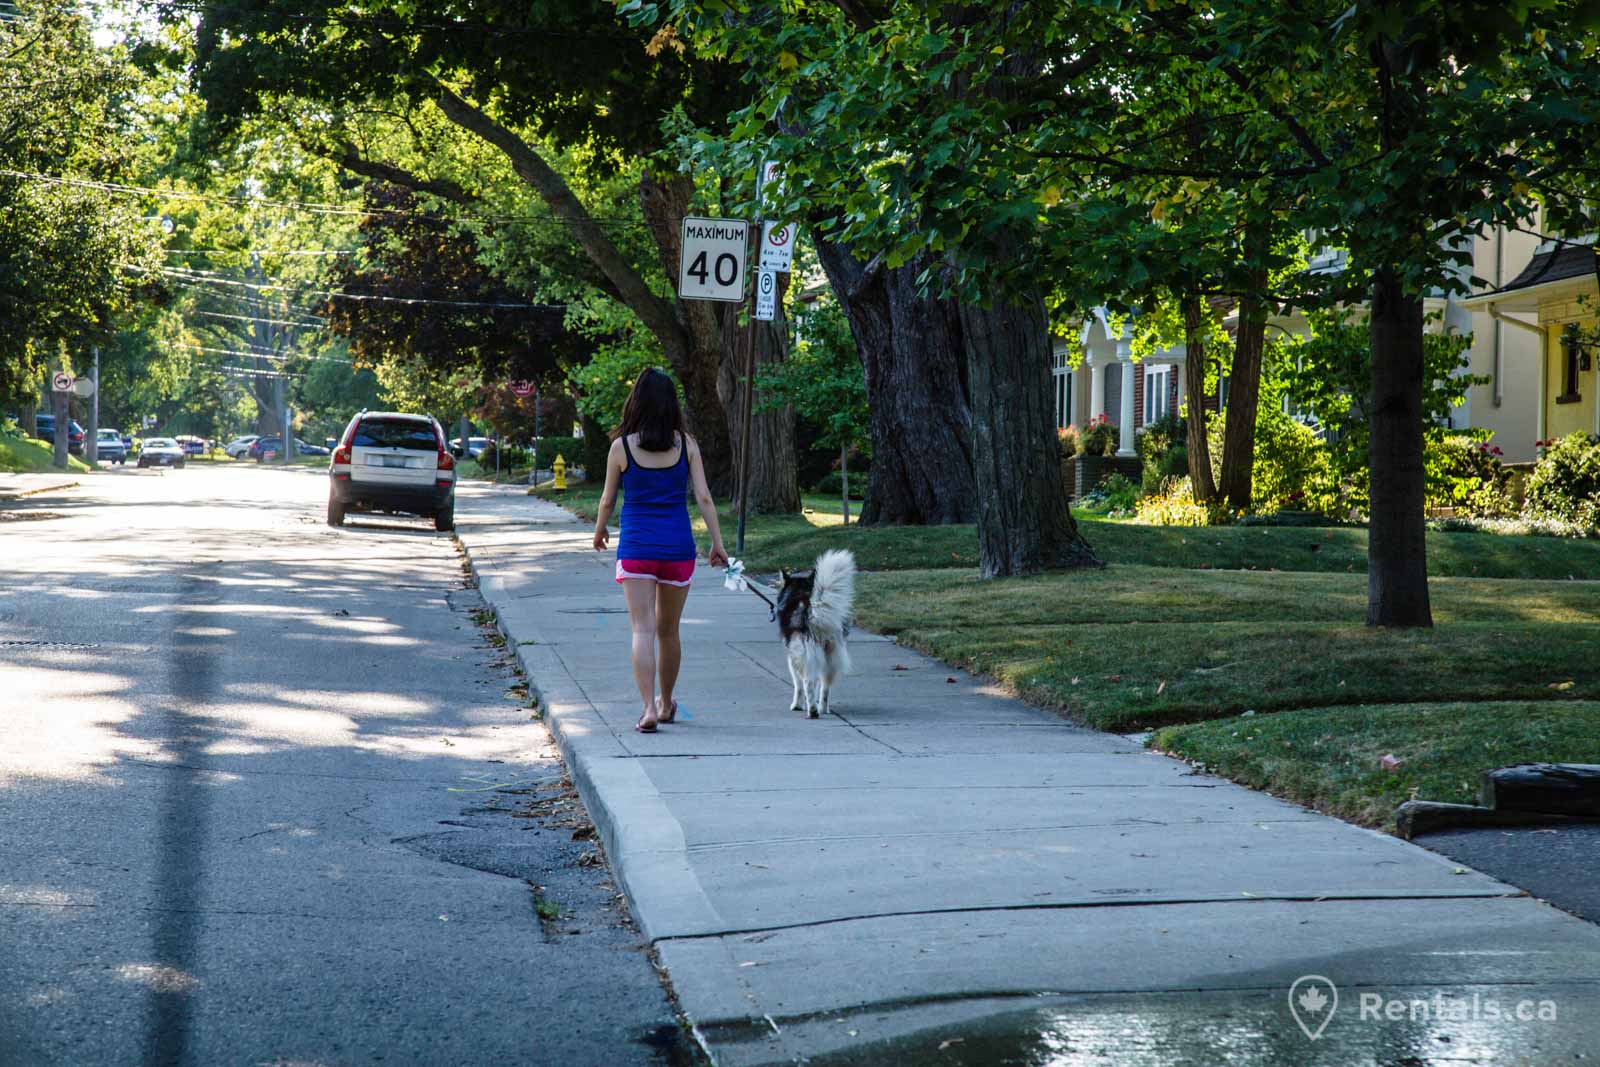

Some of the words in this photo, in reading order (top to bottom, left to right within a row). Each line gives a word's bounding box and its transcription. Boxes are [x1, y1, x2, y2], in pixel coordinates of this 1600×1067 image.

[686, 226, 744, 241] MAXIMUM
[687, 250, 738, 286] 40
[764, 278, 770, 289] P
